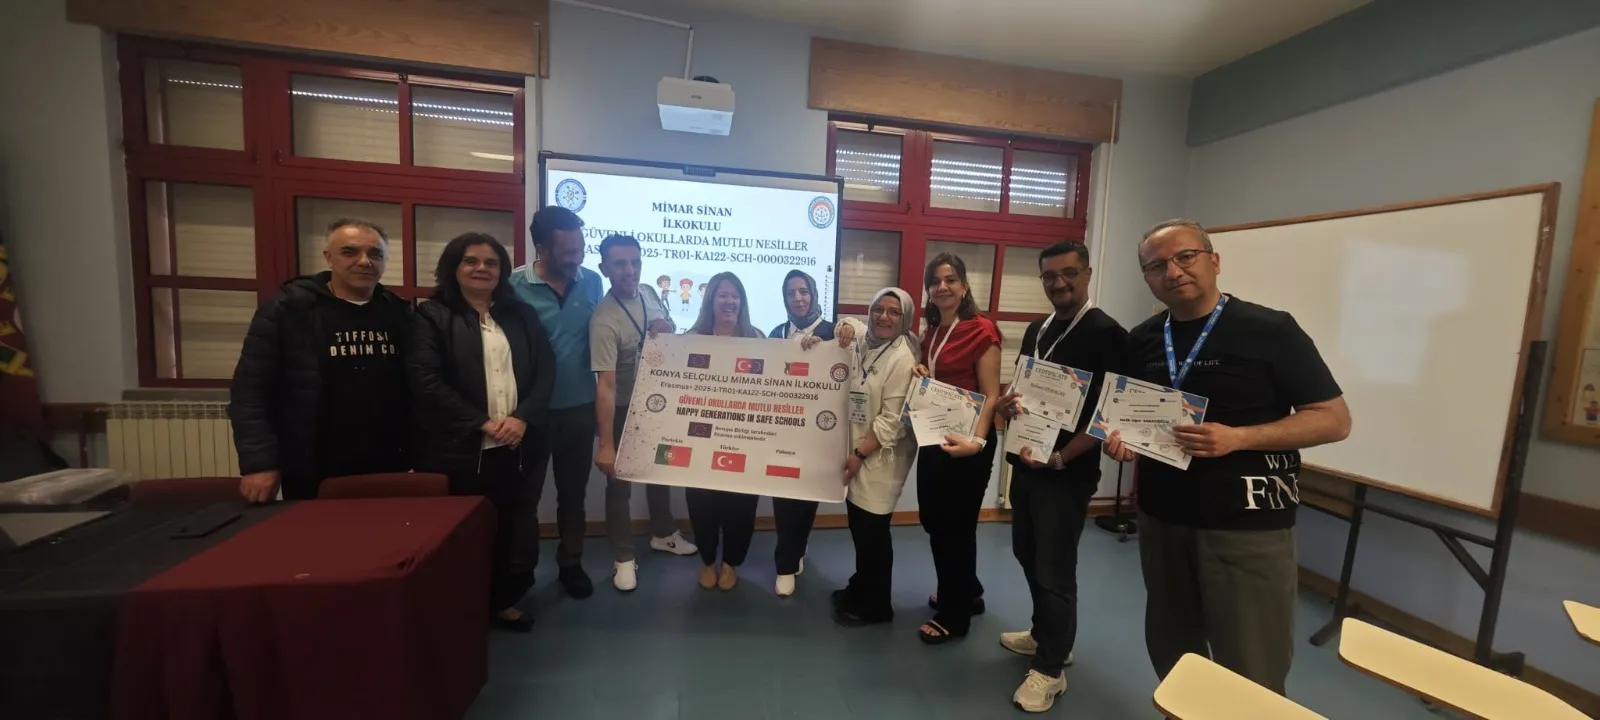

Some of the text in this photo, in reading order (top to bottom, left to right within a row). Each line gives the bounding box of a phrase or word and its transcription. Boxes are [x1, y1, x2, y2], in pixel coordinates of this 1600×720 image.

[652, 201, 732, 216] MİMAR SİNAN
[663, 217, 721, 231] İLKOKULU
[637, 232, 709, 246] OKULLARDA
[712, 236, 753, 248] MUTLU
[756, 239, 808, 251] NESİLLER
[640, 247, 816, 266] 025-TR01-KA122-SCH-0000322916
[335, 330, 388, 342] TIFFOSI
[330, 344, 374, 356] DENIM
[650, 368, 841, 391] KONYA SELÇUKLU MİMAR SİNAN İLKOKULU
[660, 381, 692, 390] Erasmus+
[679, 394, 804, 415] GÜVENLİ OKULLARDA MUTLU NESİLLER
[676, 406, 806, 427] HAPPY GENERATIONS IN SAFE SCHOOLS
